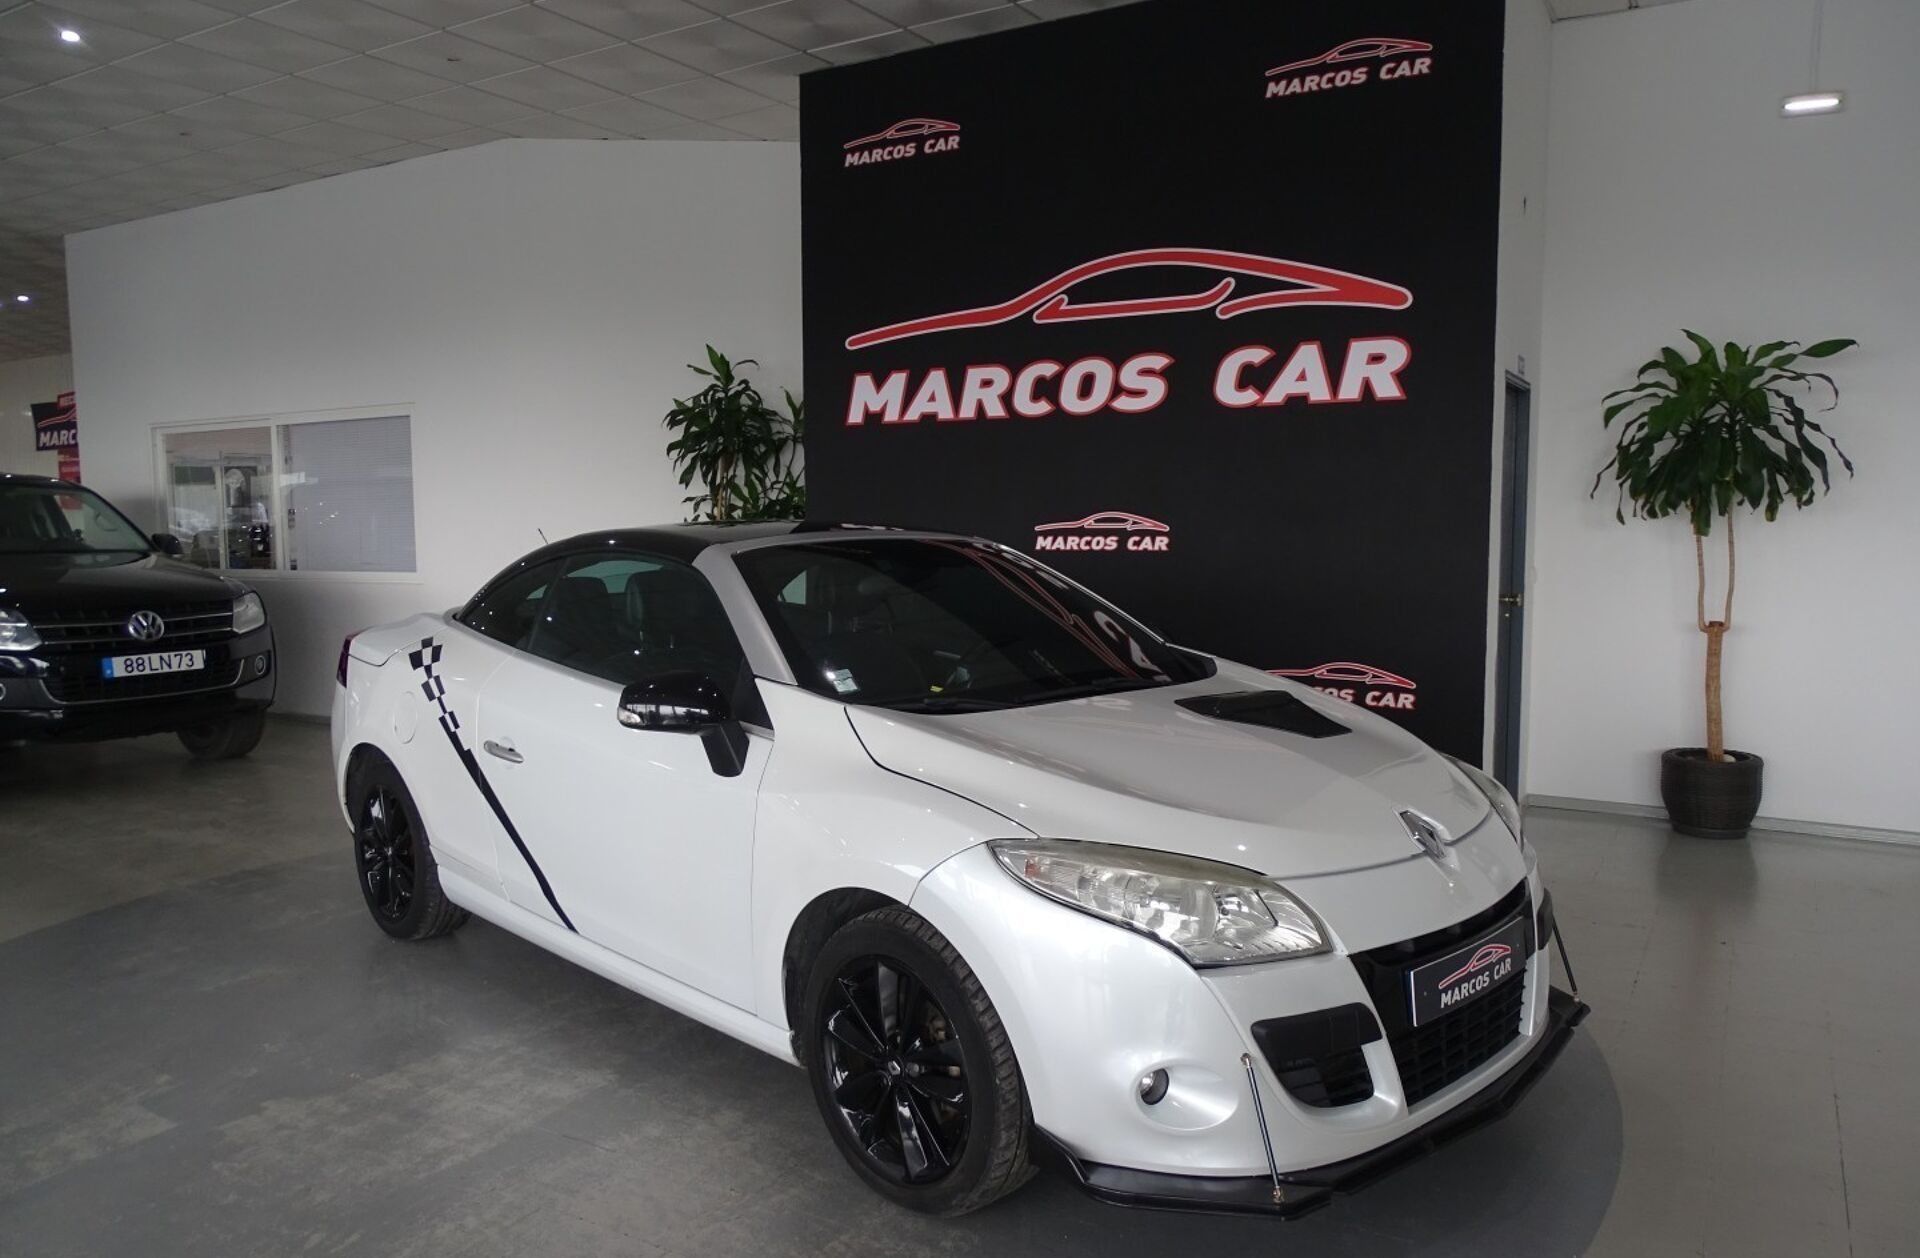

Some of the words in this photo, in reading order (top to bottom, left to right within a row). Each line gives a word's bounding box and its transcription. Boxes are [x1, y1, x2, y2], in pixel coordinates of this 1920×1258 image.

[1265, 67, 1369, 98] MARCOS
[1379, 57, 1432, 80] CAR
[844, 142, 917, 167] MARCOS
[924, 135, 960, 154] CAR
[845, 351, 1175, 426] MARCOS
[1213, 336, 1412, 408] CAR
[1035, 535, 1119, 551] MARCOS
[1127, 535, 1169, 551] CAR
[124, 652, 194, 674] 88LN73
[1364, 690, 1416, 709] CAR
[1440, 973, 1490, 1009] MARCOS
[1494, 957, 1512, 981] CAR
